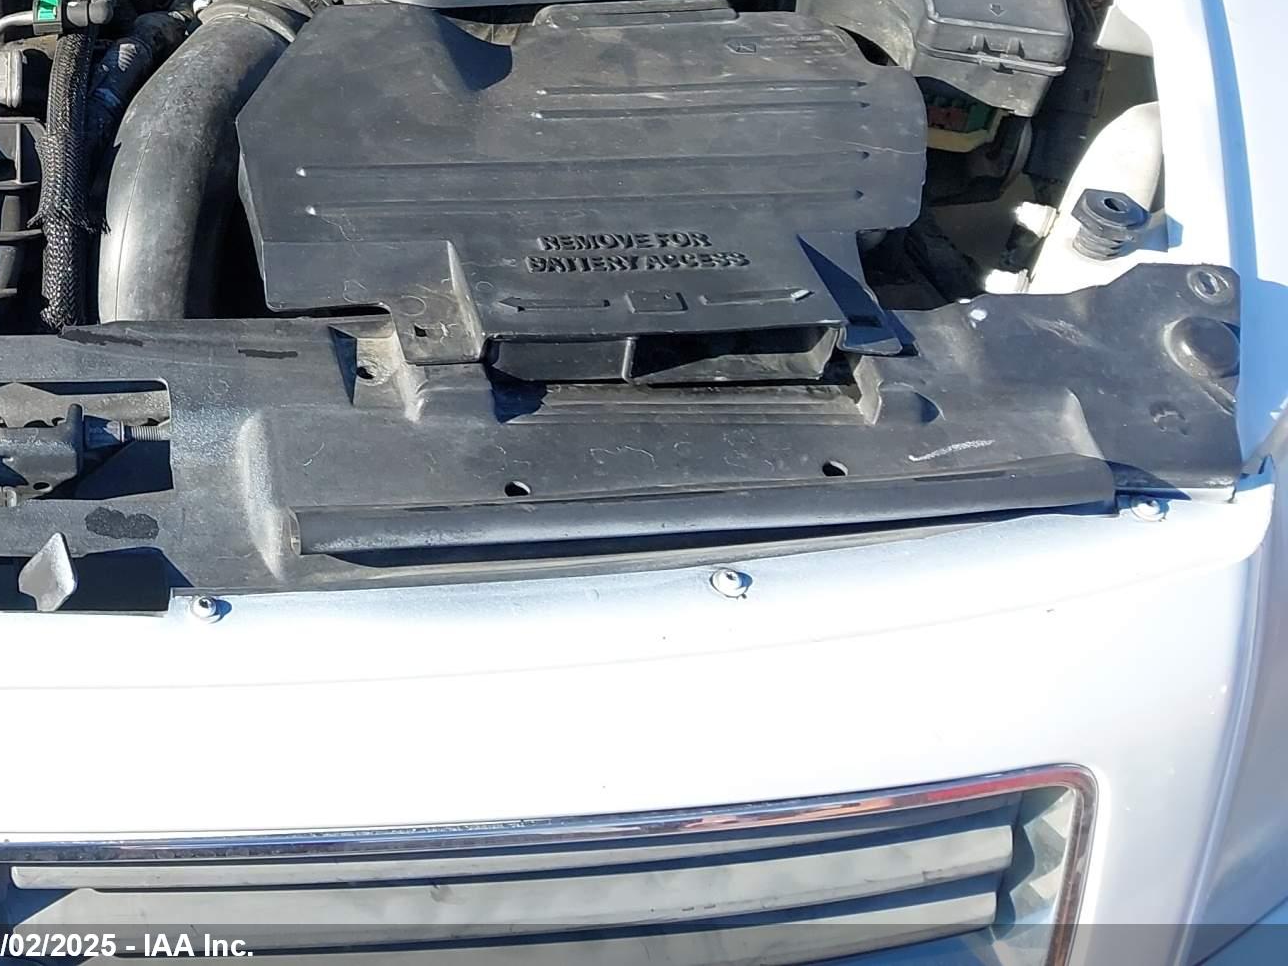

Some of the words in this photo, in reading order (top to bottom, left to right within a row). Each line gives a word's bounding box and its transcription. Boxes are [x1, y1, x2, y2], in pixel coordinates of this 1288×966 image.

[536, 232, 653, 251] REMOVE
[655, 231, 714, 248] FOR
[524, 255, 642, 274] BATTERY
[644, 251, 753, 271] ACCESS
